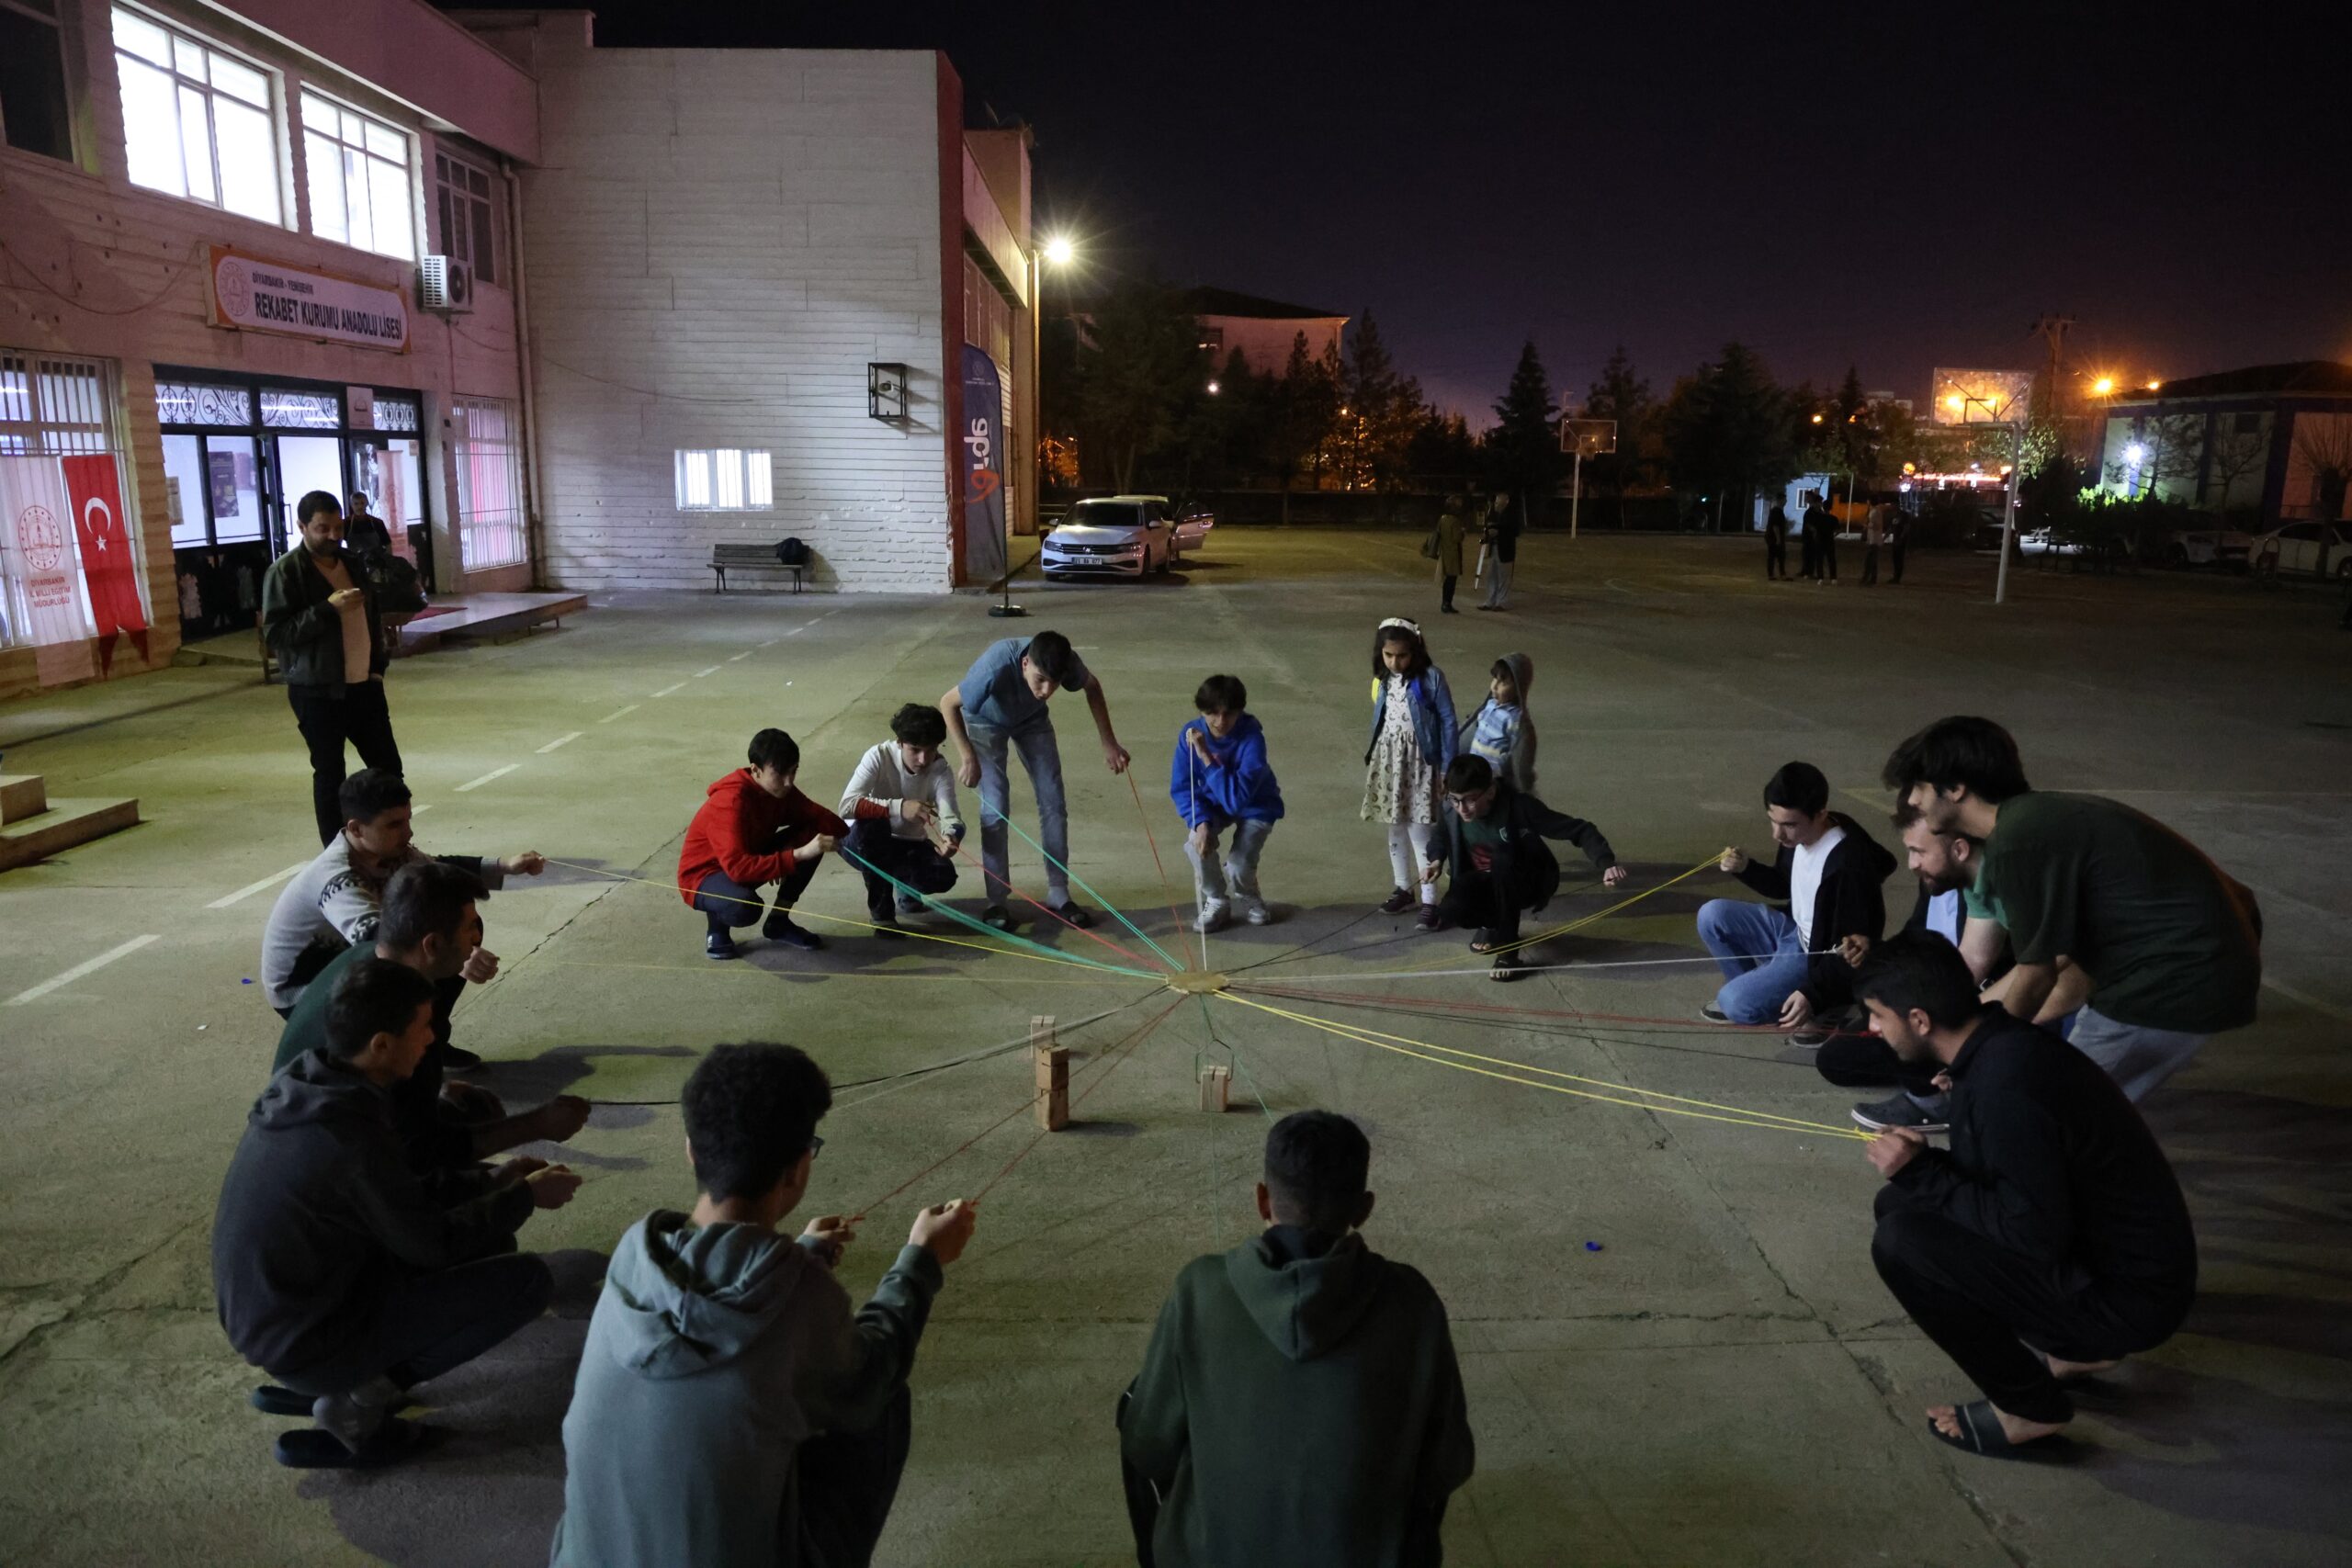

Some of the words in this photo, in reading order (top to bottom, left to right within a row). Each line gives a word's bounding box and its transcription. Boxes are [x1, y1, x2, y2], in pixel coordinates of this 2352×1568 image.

[254, 292, 299, 324] REKABET
[301, 301, 339, 330] KURUMU
[341, 309, 378, 336] ANADOLU
[379, 310, 402, 340] LİSESİ
[30, 576, 65, 586] DİYARBAKIR
[51, 586, 71, 596] EĞİTİM
